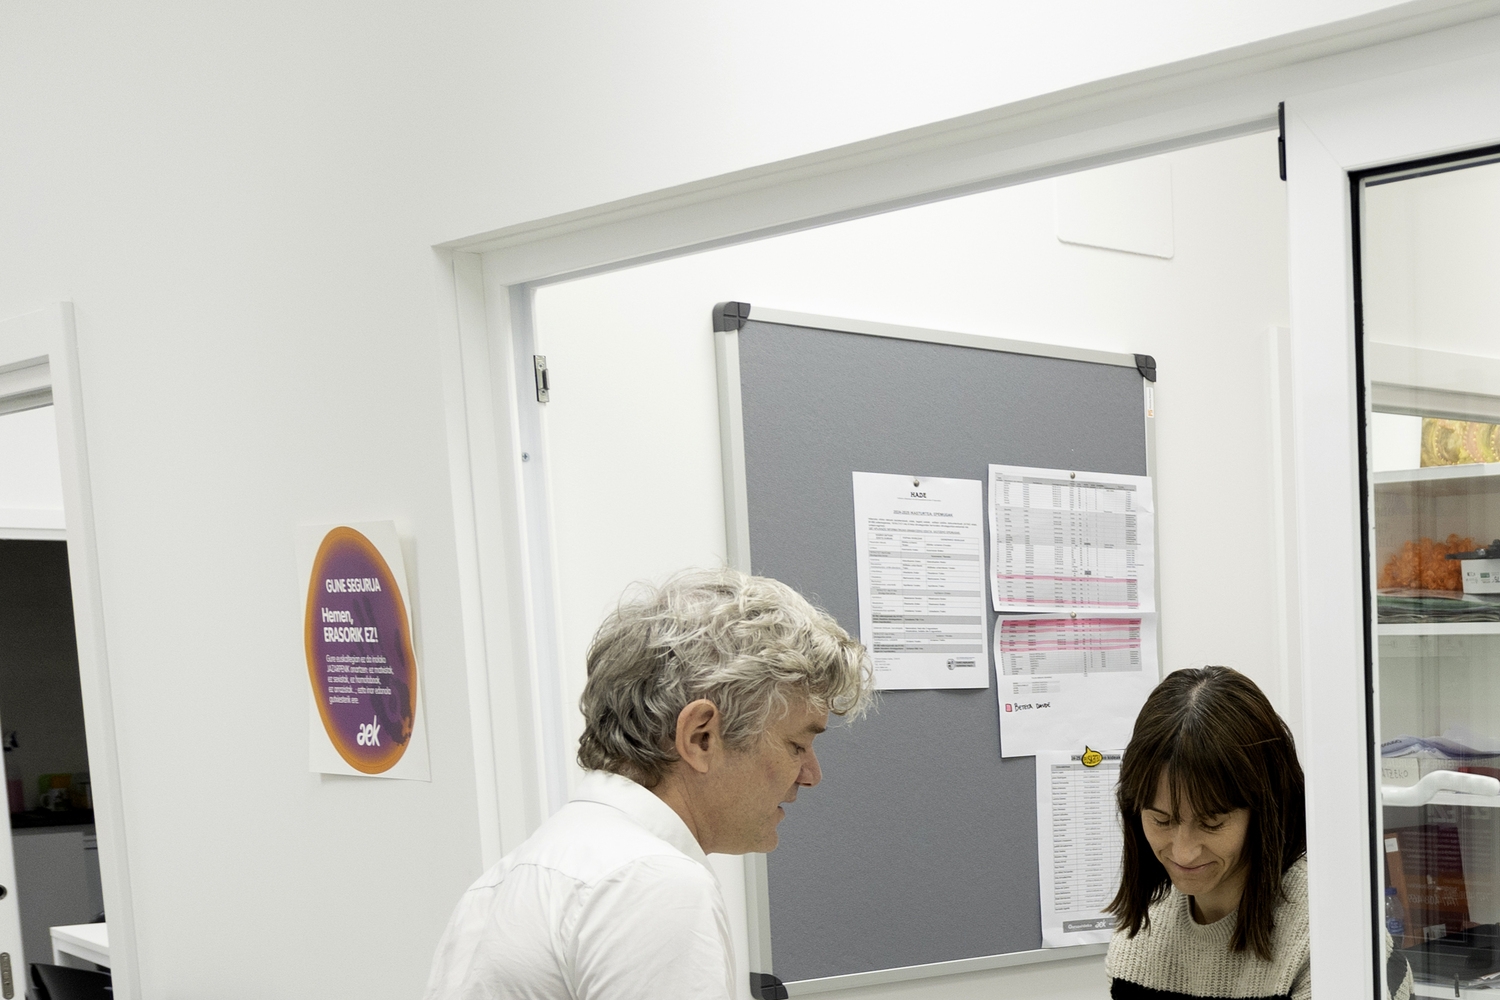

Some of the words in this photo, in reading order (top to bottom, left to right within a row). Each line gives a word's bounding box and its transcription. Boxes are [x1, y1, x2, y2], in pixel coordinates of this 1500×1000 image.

[325, 579, 347, 593] GUNE
[346, 577, 382, 592] SEGURUA
[321, 607, 354, 625] Hemen,
[323, 627, 364, 642] ERASORIK
[364, 627, 379, 643] EZ!
[356, 714, 380, 747] aek
